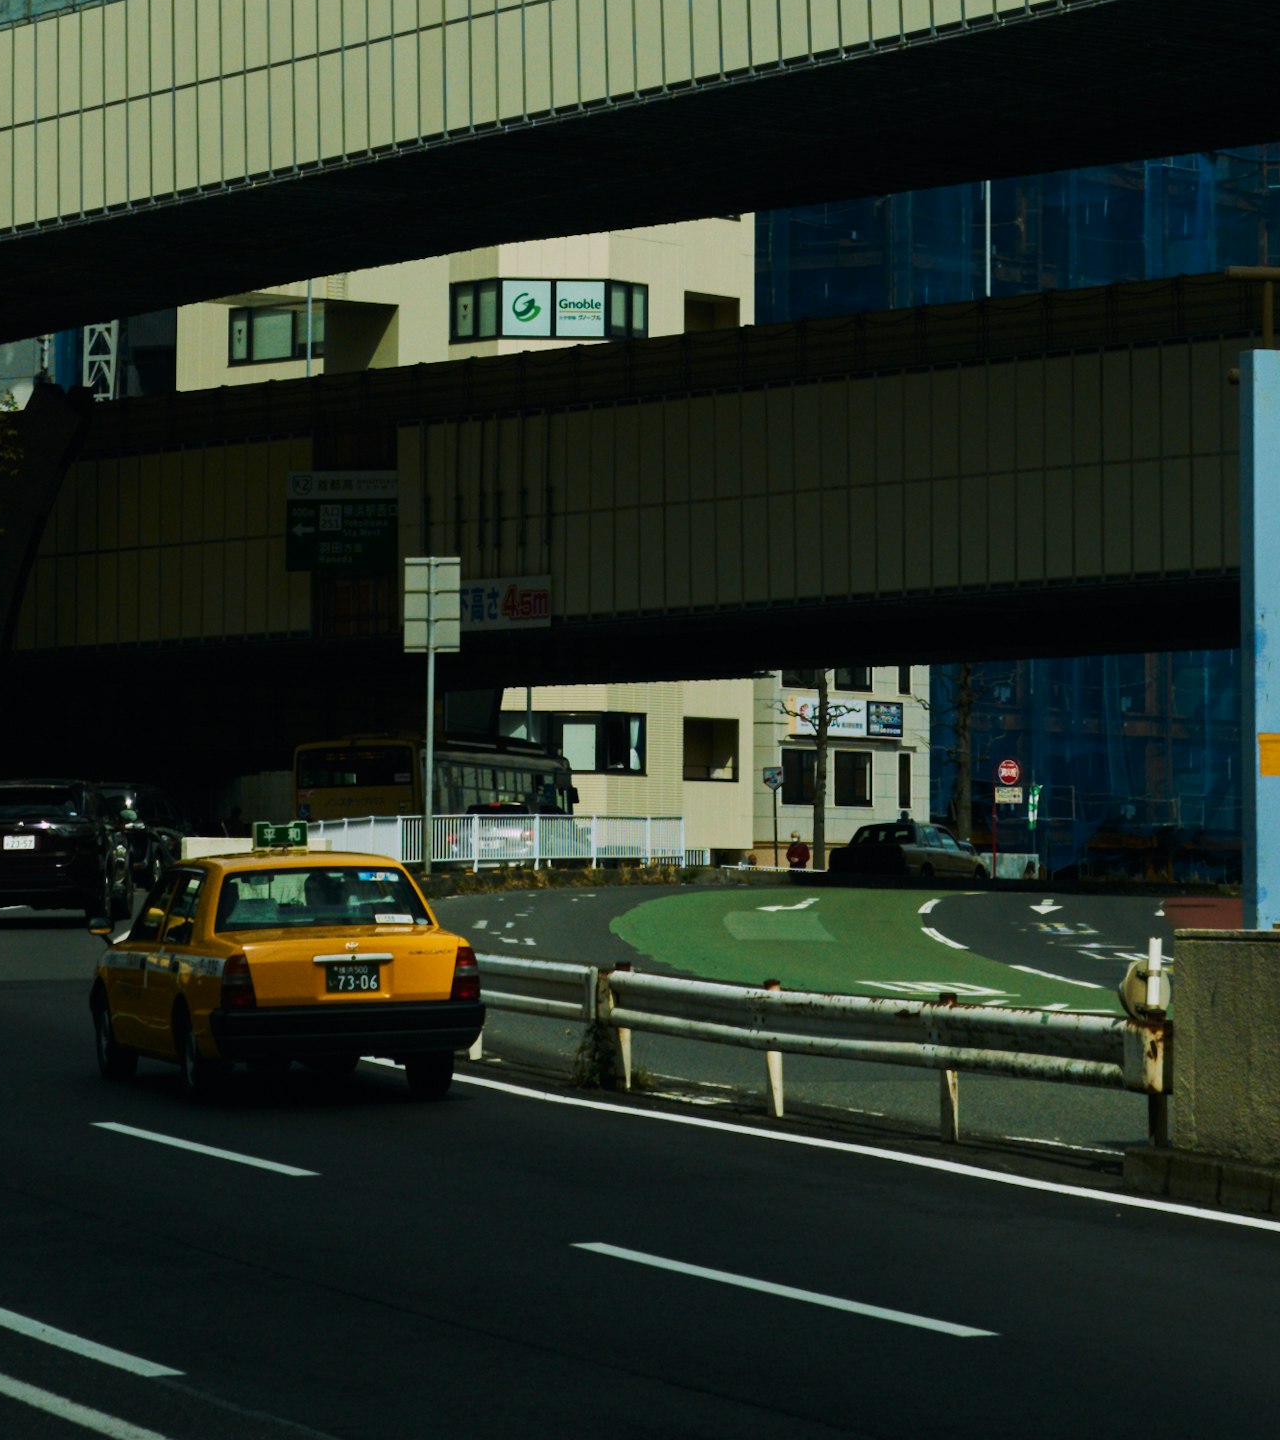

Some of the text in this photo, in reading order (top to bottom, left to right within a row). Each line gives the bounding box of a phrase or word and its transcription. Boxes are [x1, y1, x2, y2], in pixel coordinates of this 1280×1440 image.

[559, 299, 601, 309] Gnoble
[263, 828, 301, 841] 平和
[337, 975, 378, 991] 73-06
